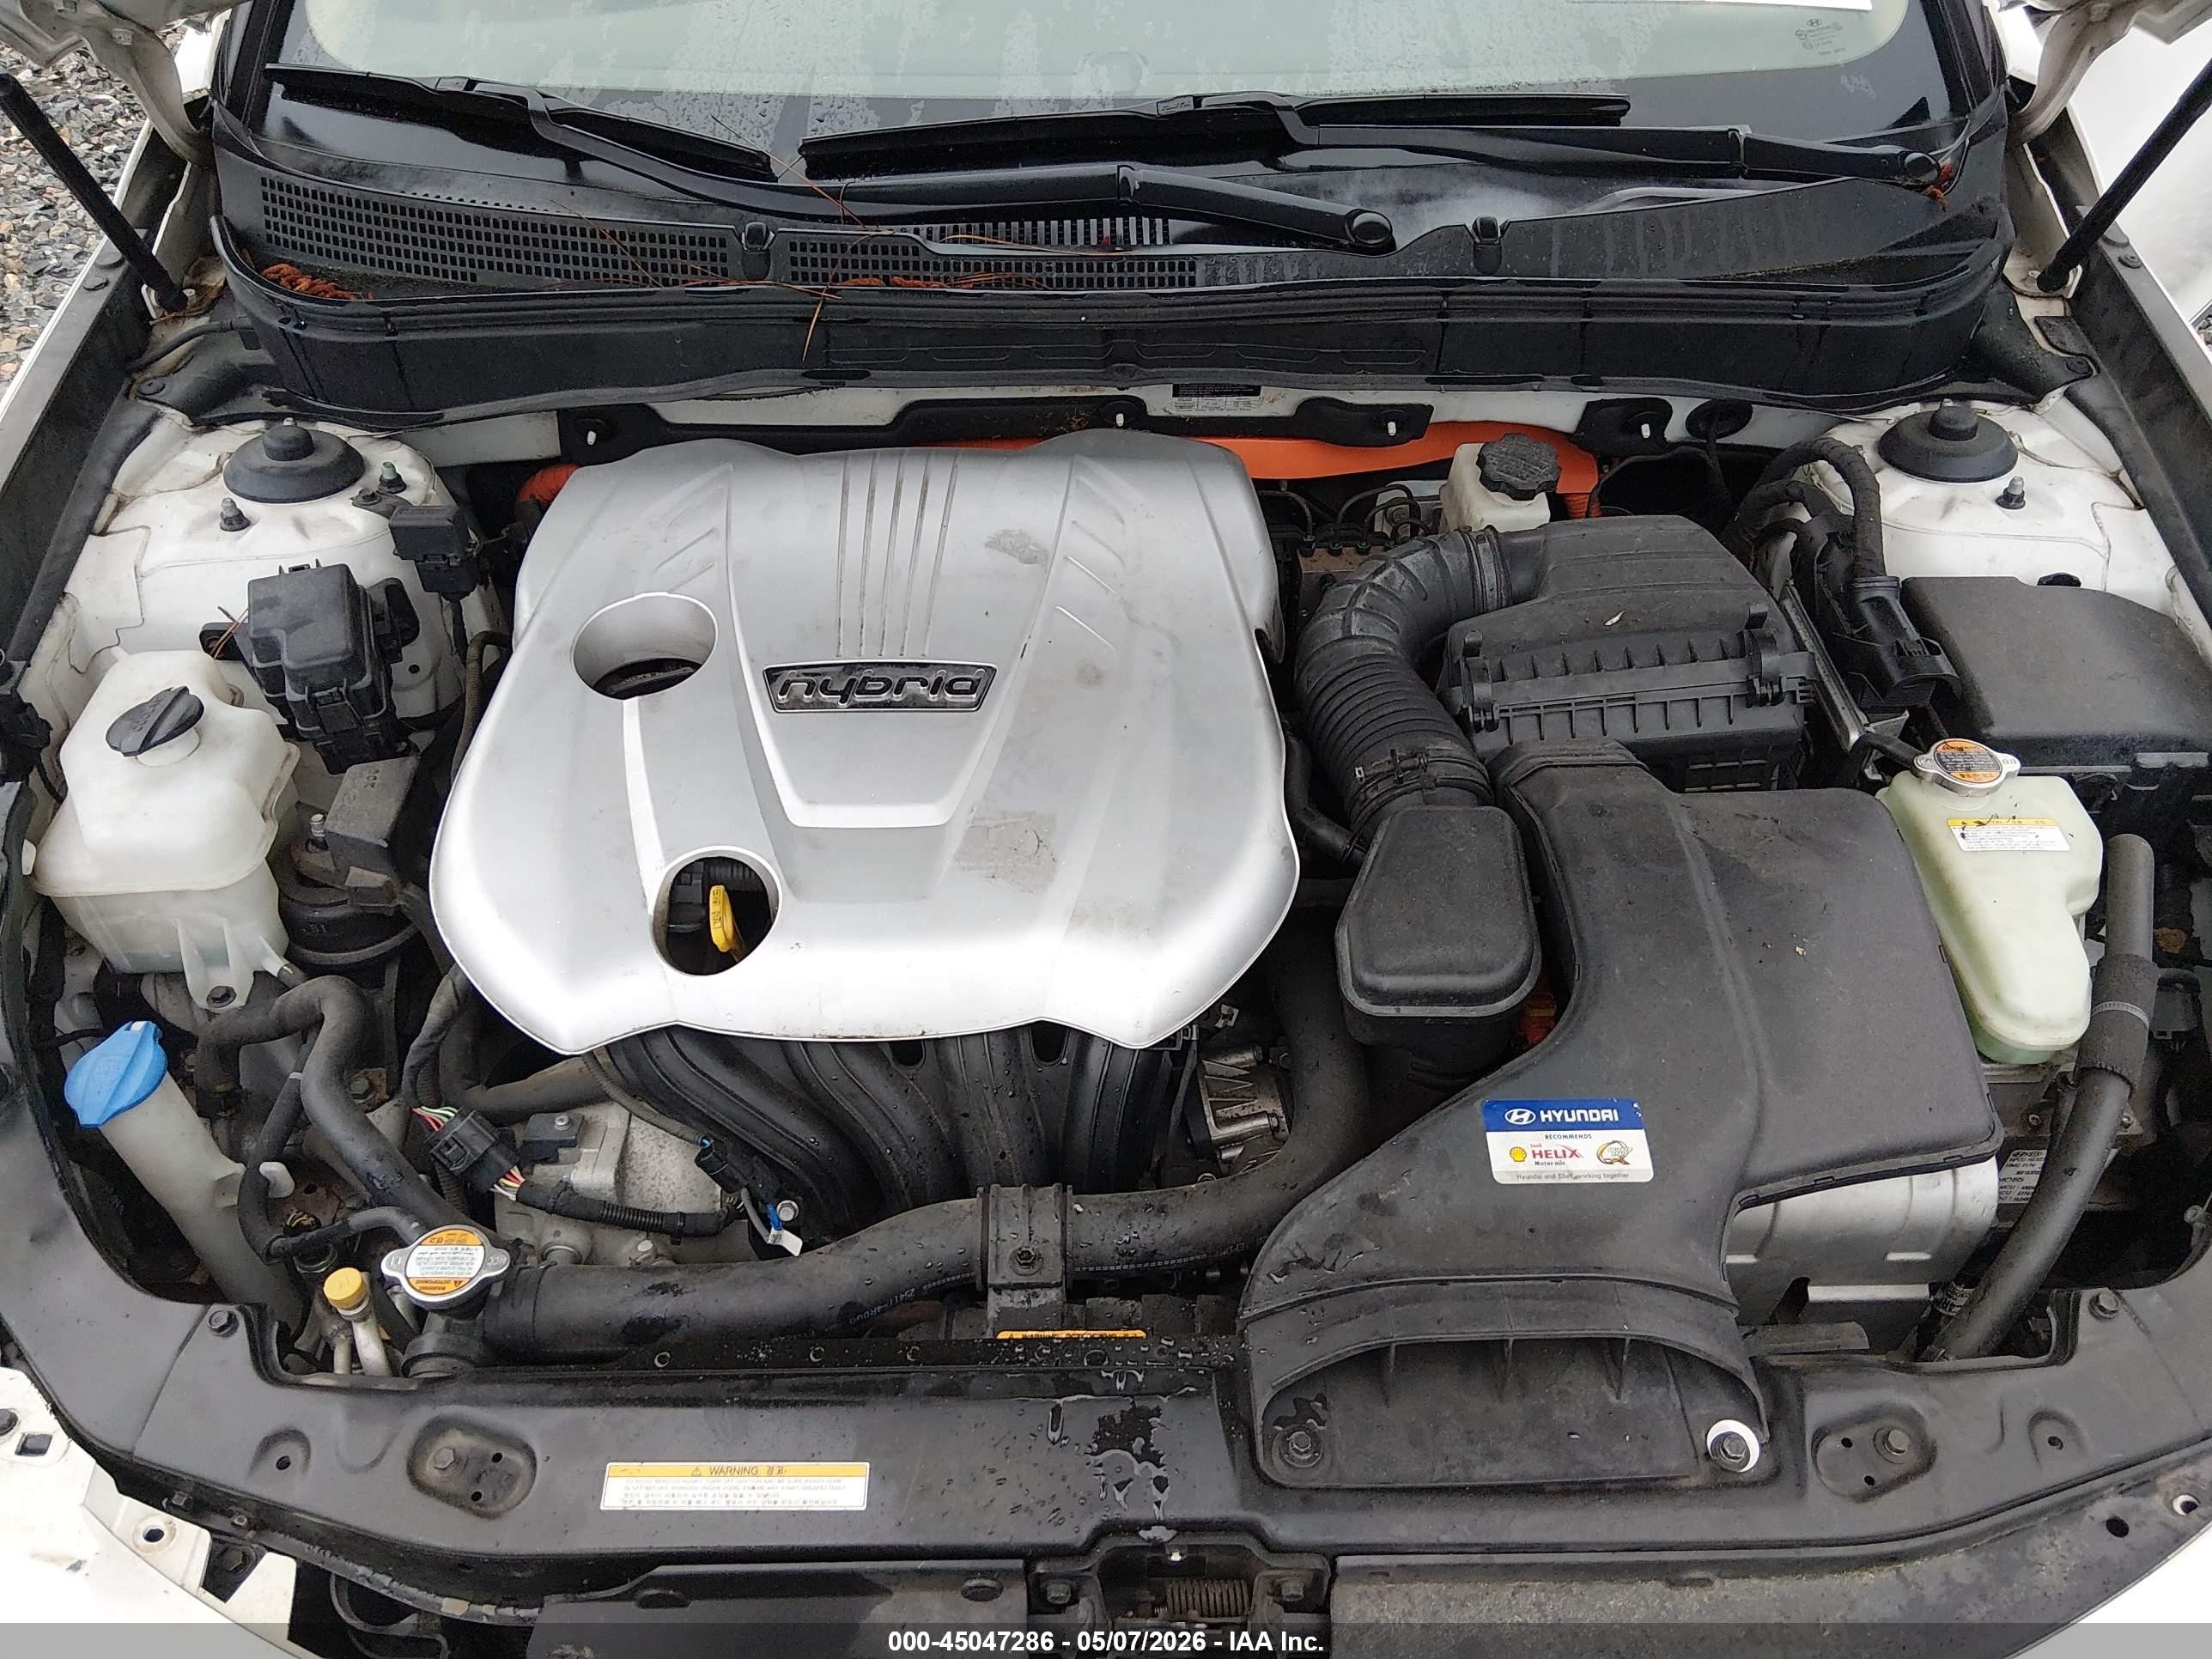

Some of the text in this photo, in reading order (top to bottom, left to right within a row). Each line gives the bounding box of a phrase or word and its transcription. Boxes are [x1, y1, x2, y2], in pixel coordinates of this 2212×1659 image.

[777, 669, 985, 708] hybrid
[1540, 1109, 1620, 1123] HYUNDAI
[1531, 1148, 1582, 1159] HELIX
[709, 1466, 759, 1476] WARNING
